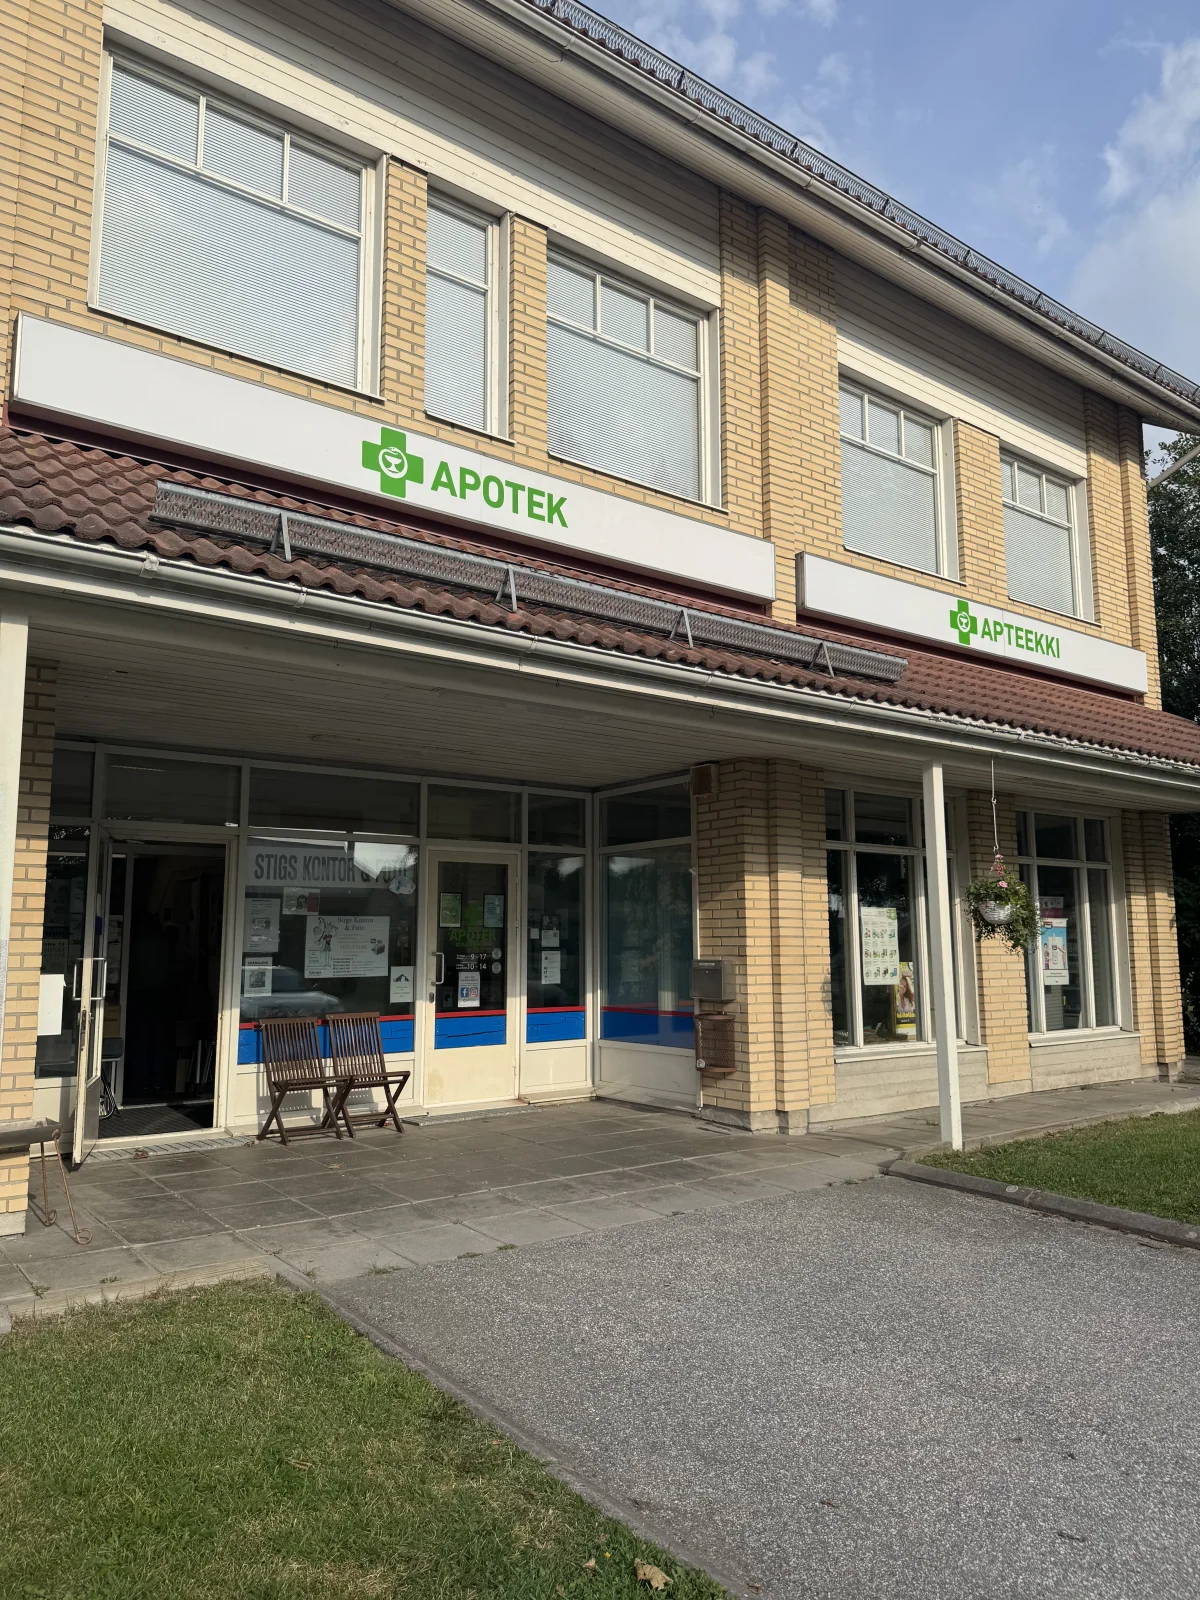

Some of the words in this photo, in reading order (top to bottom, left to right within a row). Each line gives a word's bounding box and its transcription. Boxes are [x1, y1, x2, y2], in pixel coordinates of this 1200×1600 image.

[430, 460, 568, 529] APOTEK
[980, 617, 1061, 659] APTEEKKI
[254, 853, 298, 880] STIGS
[302, 855, 356, 883] KONTOR
[449, 929, 497, 942] APOTEK
[470, 953, 475, 961] 9
[479, 953, 487, 961] 17
